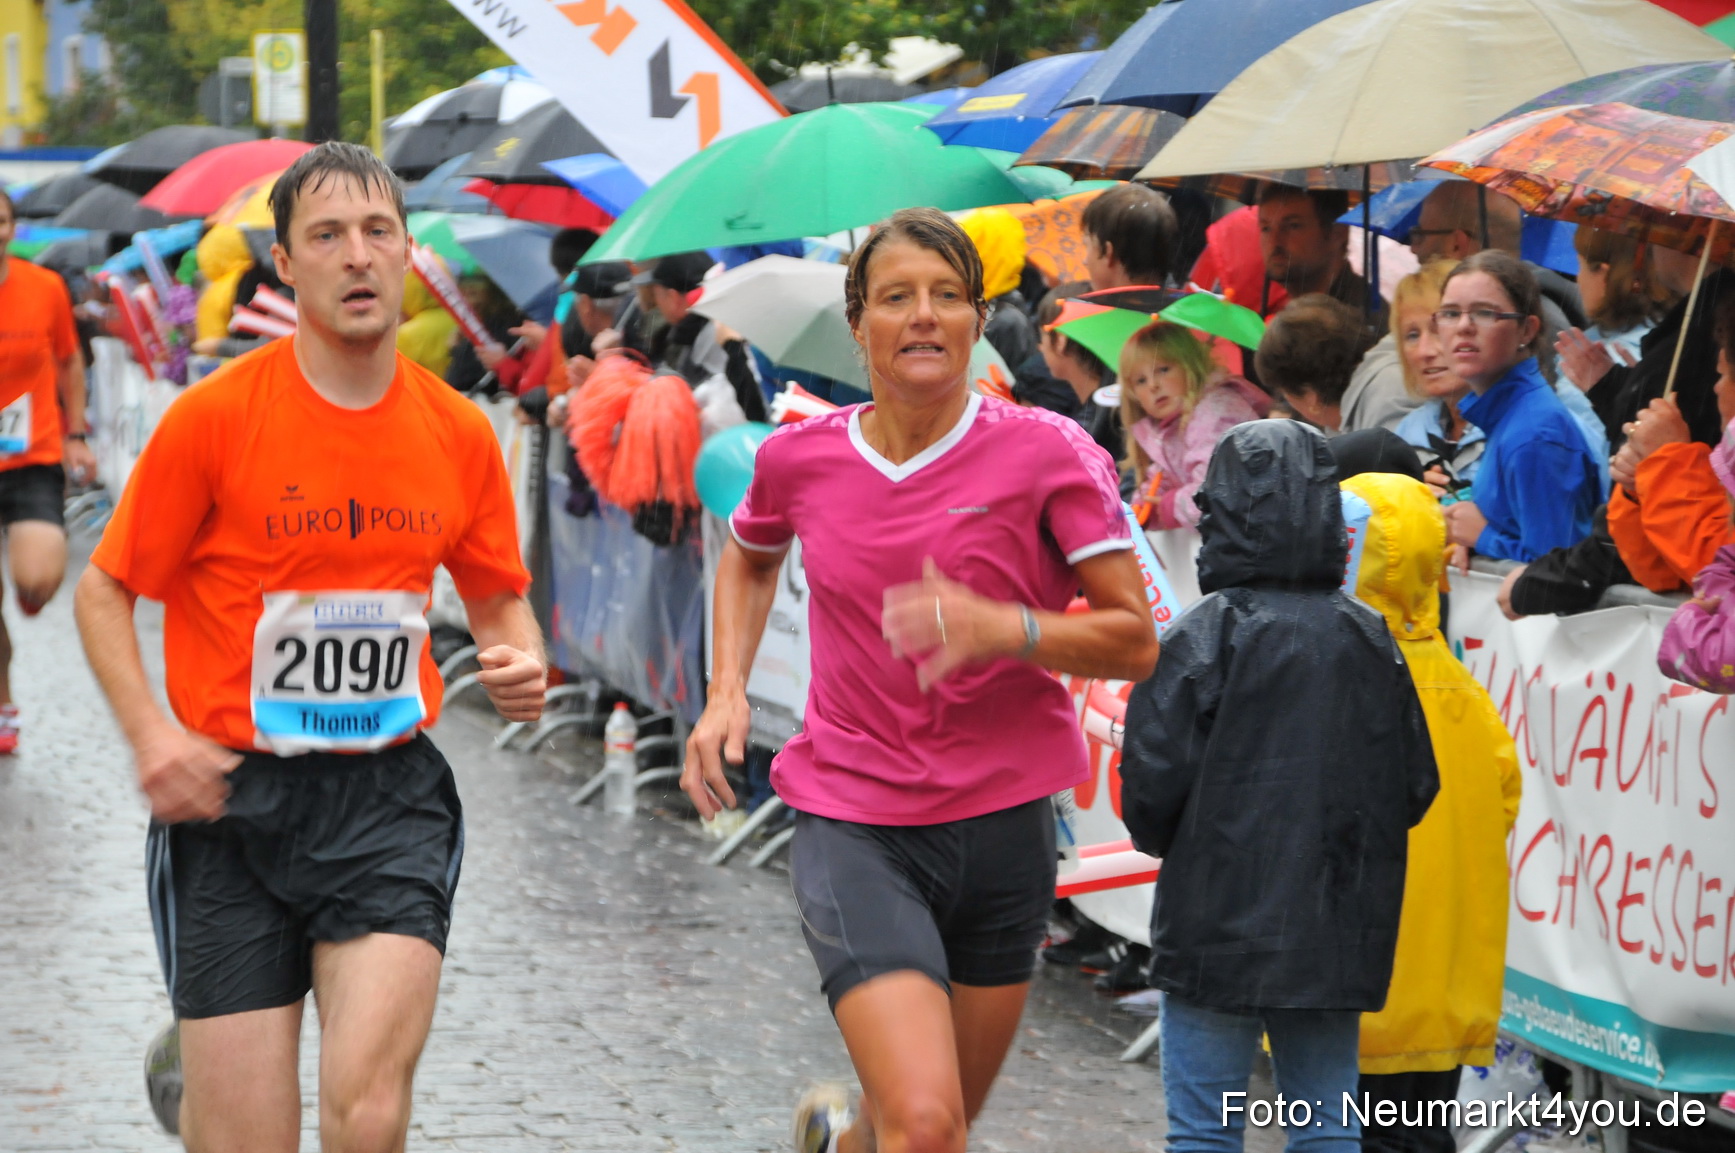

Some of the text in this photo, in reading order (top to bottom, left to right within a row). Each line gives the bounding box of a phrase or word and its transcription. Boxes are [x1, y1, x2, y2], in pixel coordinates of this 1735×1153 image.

[266, 506, 442, 540] EURO POLES
[272, 636, 409, 693] 2090
[301, 710, 381, 737] Thomas
